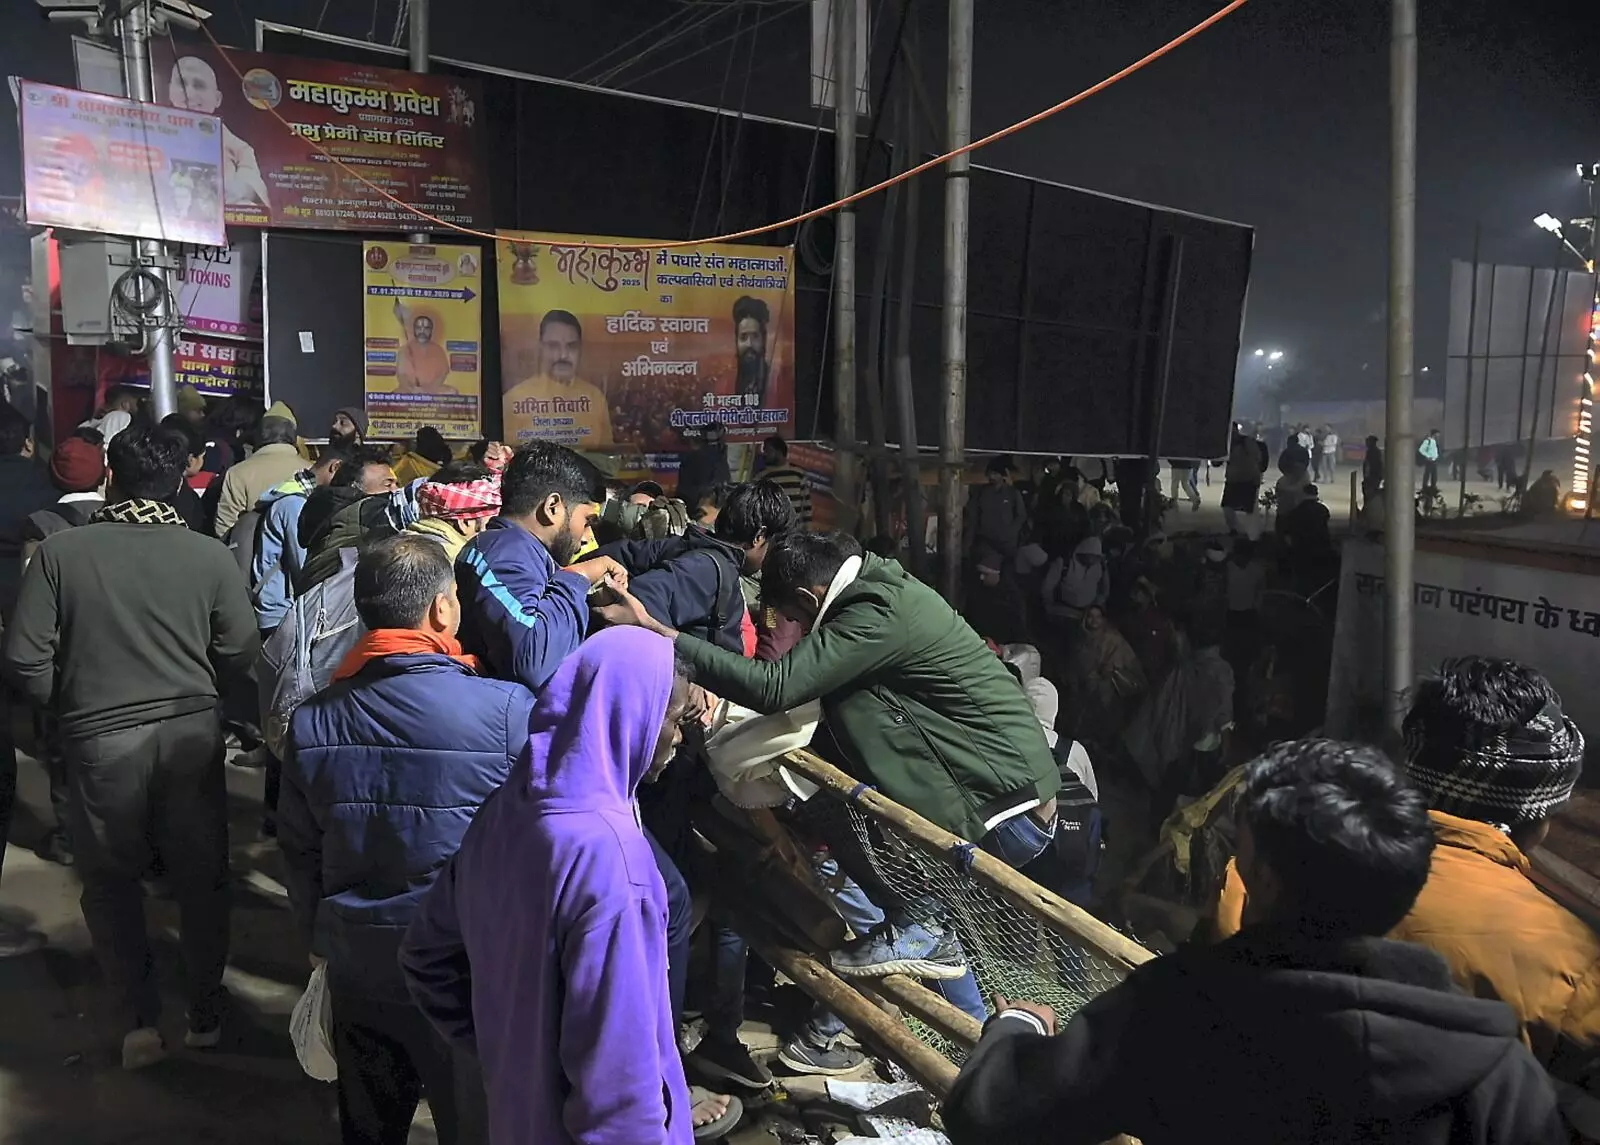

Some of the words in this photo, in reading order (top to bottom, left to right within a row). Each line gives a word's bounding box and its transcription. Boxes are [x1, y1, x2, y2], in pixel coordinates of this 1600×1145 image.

[287, 80, 388, 113] महाकुम्भ
[391, 88, 440, 116] प्रवेश
[358, 113, 392, 124] प्रयागराज
[394, 116, 414, 126] 2025
[323, 122, 358, 141] प्रेमी
[361, 127, 392, 144] संघ
[396, 130, 445, 148] शिविर
[656, 249, 667, 266] में
[671, 250, 701, 268] पधारे
[705, 252, 725, 270] संत
[190, 268, 231, 288] TOXINS
[621, 278, 641, 287] 2025
[719, 273, 734, 288] एवं
[660, 295, 672, 304] का
[606, 311, 656, 333] हार्दिक
[660, 317, 709, 333] स्वागत
[651, 339, 668, 355] एवं
[621, 358, 697, 378] अभिनन्दन
[513, 396, 551, 415] अमित
[552, 395, 591, 413] तिवारी
[702, 392, 714, 407] श्री
[744, 393, 759, 406] 108
[533, 416, 551, 426] जिला
[671, 408, 684, 426] श्री
[739, 407, 755, 424] जी
[755, 408, 788, 423] महाराज
[1447, 586, 1529, 624] परंपरा
[1533, 596, 1563, 628] के
